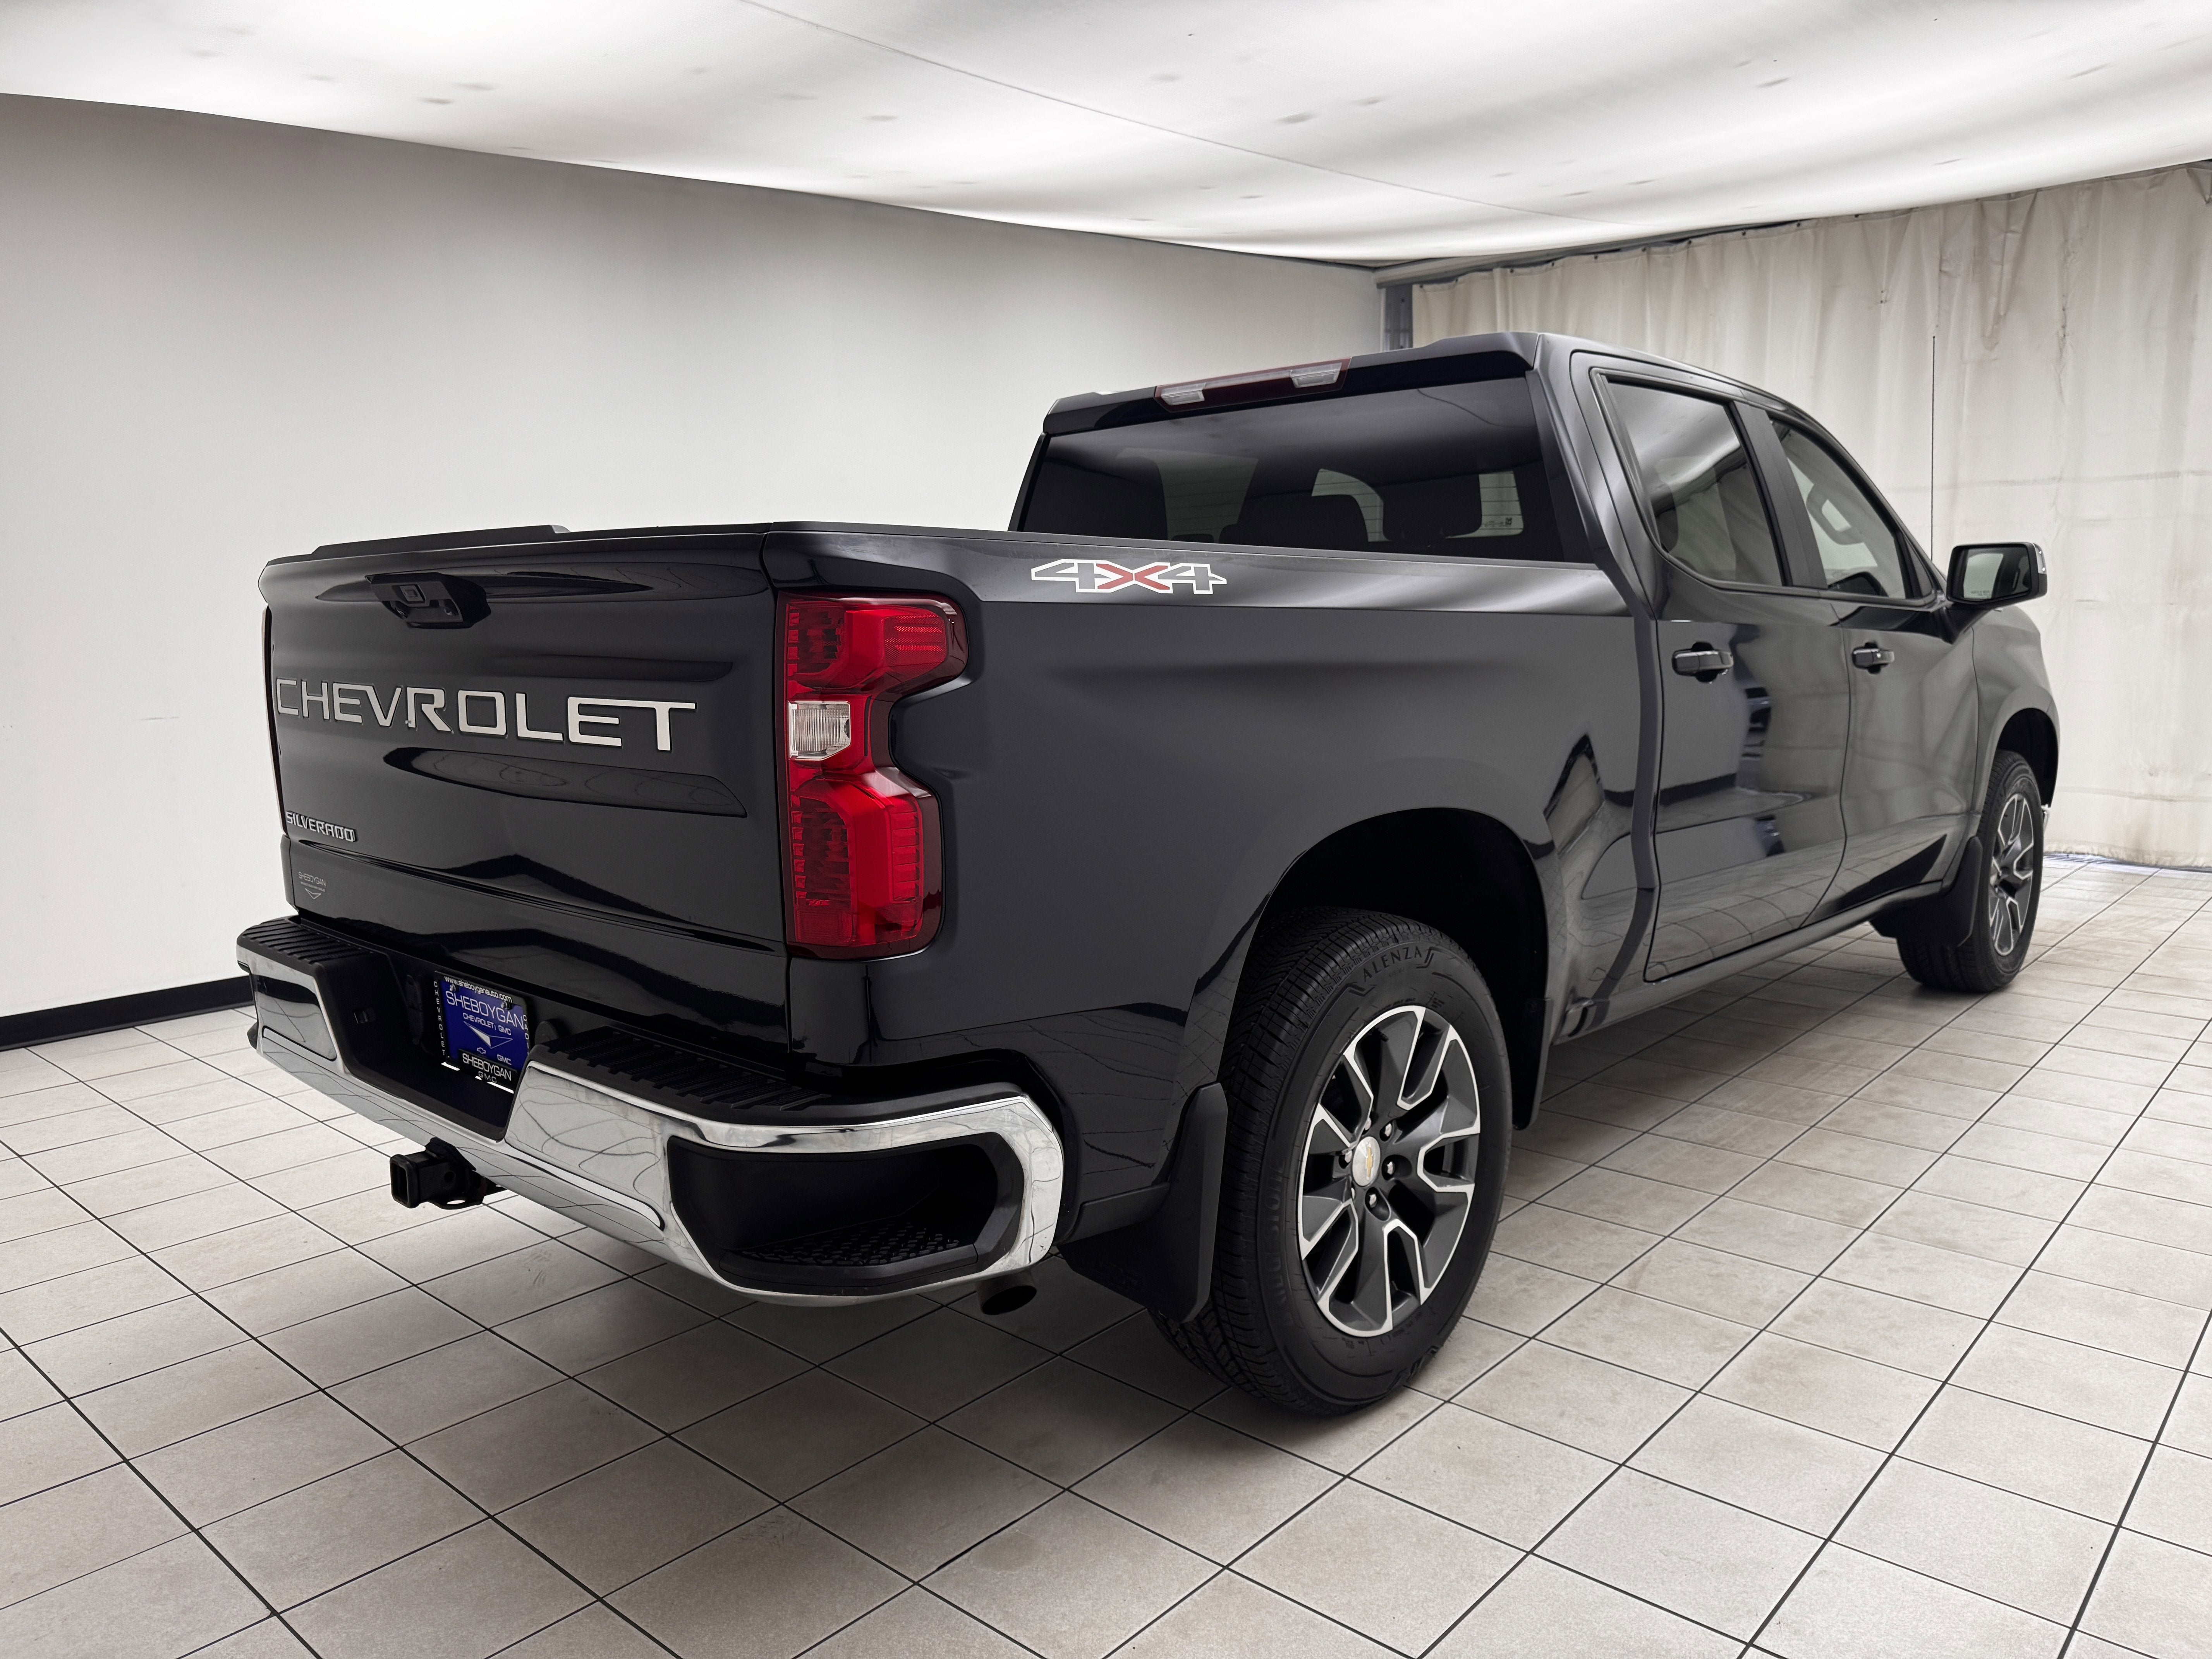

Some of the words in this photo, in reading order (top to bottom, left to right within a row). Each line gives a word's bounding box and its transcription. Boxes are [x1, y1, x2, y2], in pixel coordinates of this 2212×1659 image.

[275, 678, 696, 751] CHEVROLET
[286, 811, 356, 842] SILVERADO
[1363, 945, 1422, 982] ALENZA
[444, 976, 513, 1003] www.sheboyganauto.com
[433, 981, 446, 1056] CHEVROLET
[445, 990, 524, 1030] SHEBOYGAN
[463, 1012, 494, 1029] CHEVROLET
[498, 1025, 511, 1036] GMC
[462, 1053, 512, 1081] SHEBOYGAN
[497, 1054, 512, 1065] GMC
[478, 1071, 497, 1083] GMC
